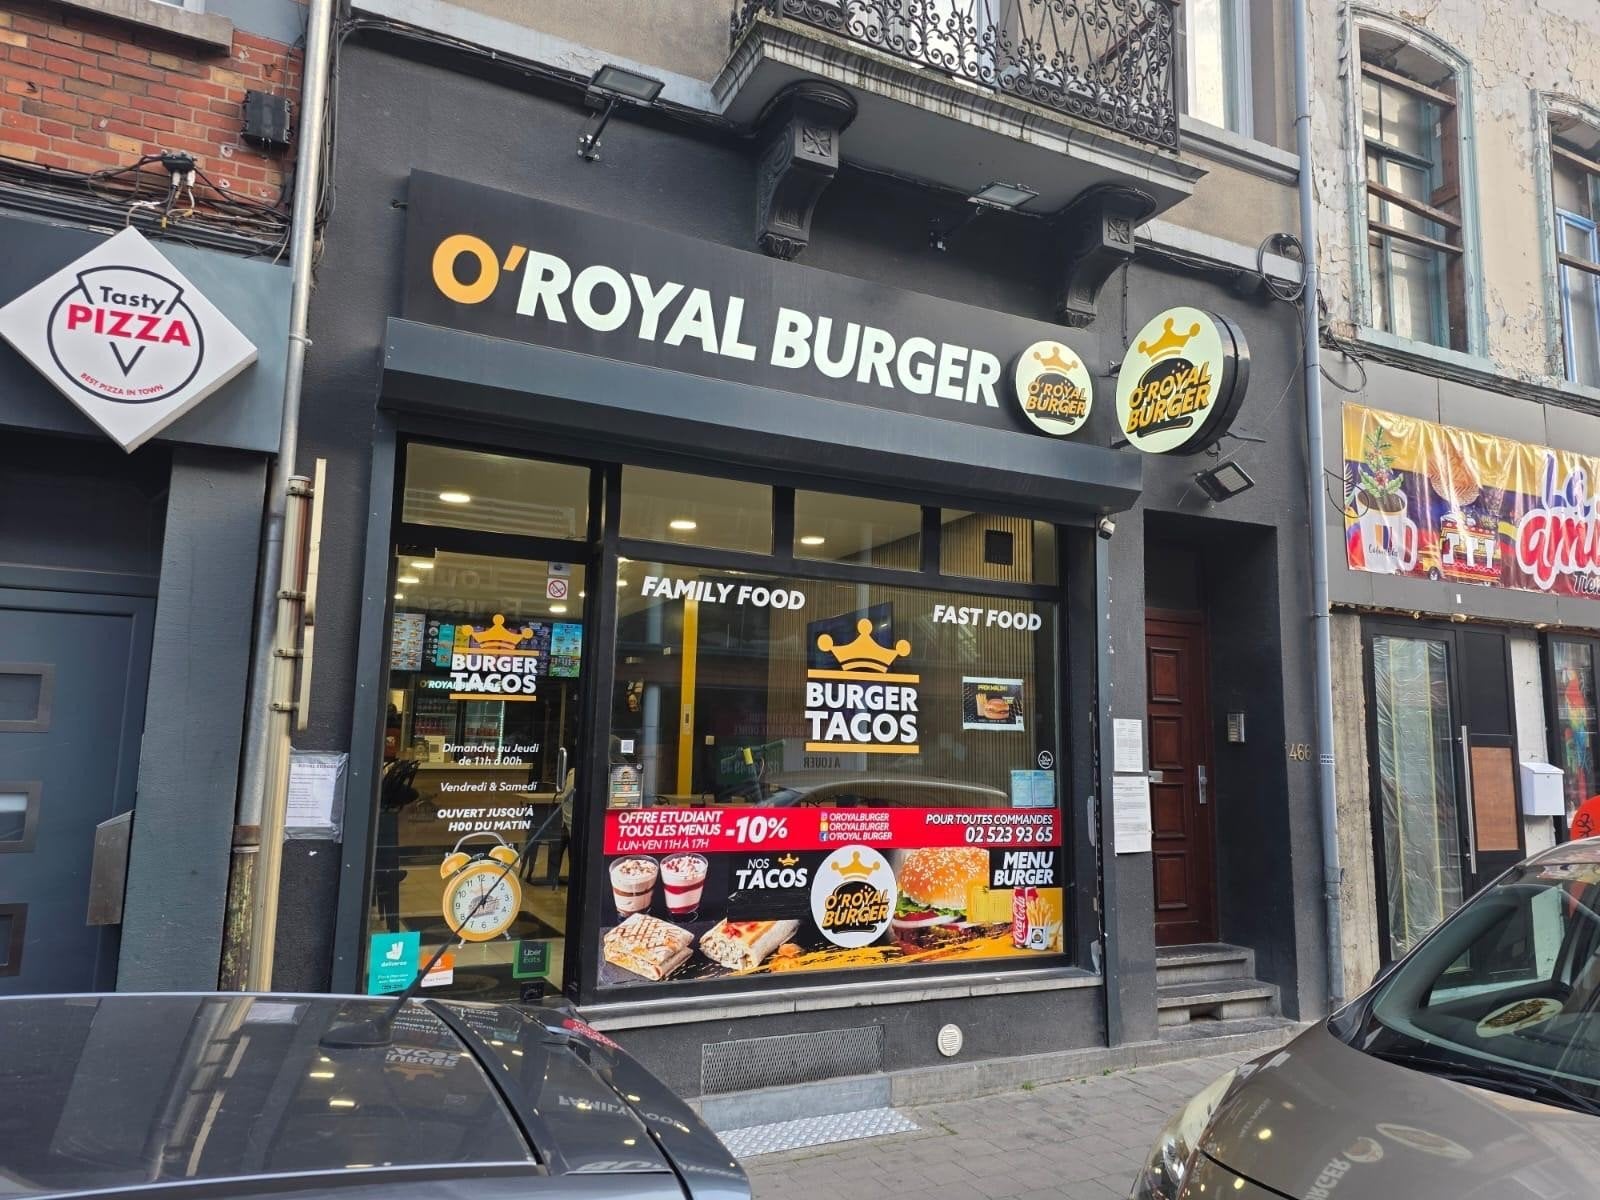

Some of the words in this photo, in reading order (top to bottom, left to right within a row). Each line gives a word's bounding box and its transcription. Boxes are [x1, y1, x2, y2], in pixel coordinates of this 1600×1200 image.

[99, 285, 167, 315] Tasty
[67, 304, 191, 347] PIZZA
[432, 233, 757, 361] O'ROYAL
[770, 307, 1001, 408] BURGER
[80, 372, 100, 389] BEST
[98, 384, 125, 396] PIZZA
[137, 384, 164, 396] TOWN
[1028, 380, 1088, 400] O'ROYAL
[1129, 361, 1212, 410] O'ROYAL
[1026, 396, 1086, 418] BURGER
[1126, 384, 1211, 434] BURGER
[641, 575, 735, 603] FAMILY
[737, 585, 806, 610] FOOD
[932, 604, 984, 626] FAST
[986, 609, 1042, 632] FOOD
[451, 653, 538, 674] BURGER
[449, 672, 537, 694] TACOS
[806, 681, 919, 712] BURGER
[805, 711, 918, 744] TACOS
[442, 743, 495, 754] Dimanche
[498, 744, 512, 754] au
[512, 742, 539, 753] Jeudi
[1289, 743, 1311, 761] 466
[458, 757, 472, 766] de
[475, 756, 492, 766] 11h
[503, 756, 522, 766] 00h
[440, 782, 487, 792] Vendredi
[489, 782, 497, 792] &
[499, 781, 537, 792] Samedi
[437, 808, 486, 819] OUVERT
[486, 806, 534, 818] JUSQU'À
[618, 811, 657, 824] OFFRE
[659, 811, 724, 823] ETUDIANT
[829, 812, 890, 822] OROYALBURGER
[925, 814, 955, 825] POUR
[955, 814, 992, 825] TOUTES
[994, 814, 1053, 826] COMMANDES
[448, 821, 472, 832] H00
[474, 821, 492, 831] DU
[494, 820, 531, 831] MATIN
[618, 825, 654, 837] TOUS
[655, 825, 676, 836] LES
[677, 824, 721, 836] MENUS
[725, 815, 788, 844] -10%
[829, 822, 889, 831] OROYALBURGER
[965, 827, 985, 843] 02
[987, 827, 1013, 843] 523
[1015, 827, 1034, 843] 93
[1035, 826, 1053, 843] 65
[617, 840, 662, 851] LUN-VEN
[664, 839, 683, 849] 11H
[691, 838, 709, 849] 17H
[829, 832, 862, 841] O'ROYAL
[862, 831, 893, 841] BURGER
[747, 858, 770, 870] NOS
[1002, 851, 1054, 870] MENU
[736, 868, 808, 890] TACOS
[993, 869, 1054, 887] BURGER
[823, 887, 889, 911] O'ROYAL
[822, 903, 889, 927] BURGER
[523, 956, 541, 964] Eats
